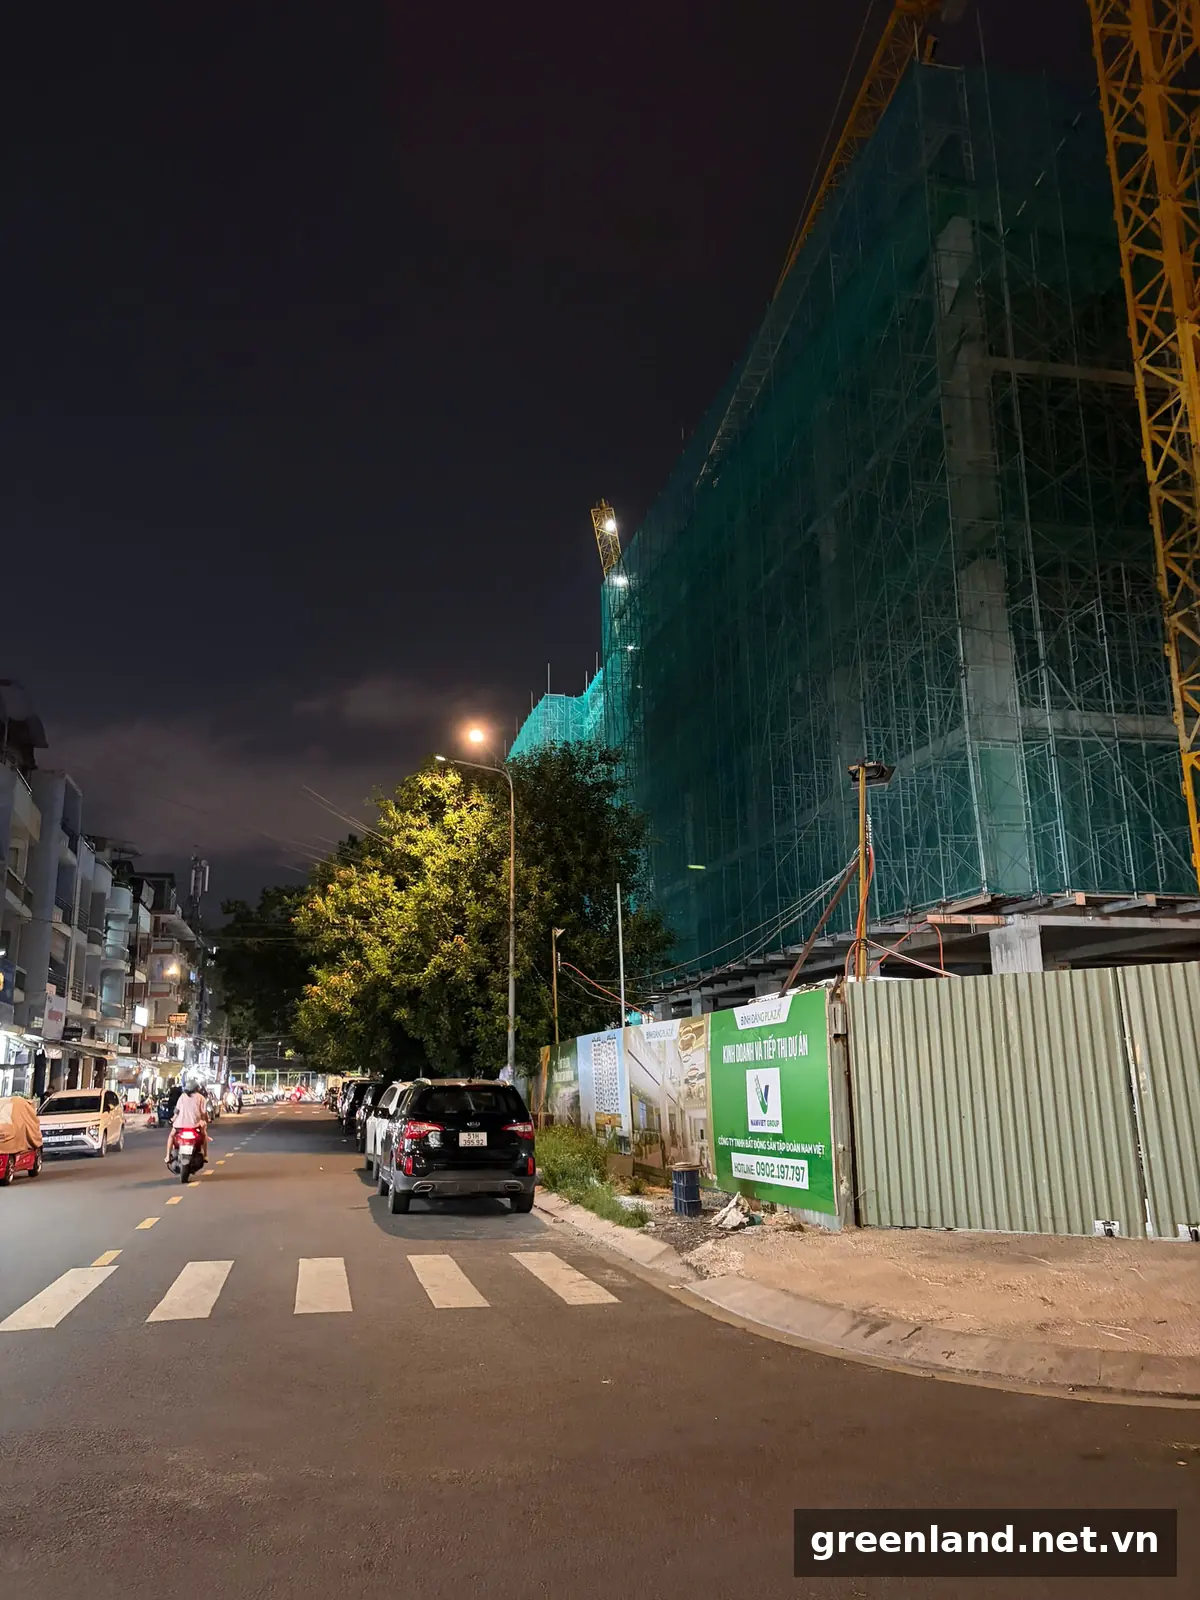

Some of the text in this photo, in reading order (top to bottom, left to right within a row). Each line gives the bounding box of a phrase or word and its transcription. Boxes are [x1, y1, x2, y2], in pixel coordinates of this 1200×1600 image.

[722, 1030, 808, 1064] KINH DOANH VÀ TIẾP THỊ DỰ ÁN
[766, 1119, 780, 1127] GROUP
[718, 1134, 825, 1158] CÔNG TY TNHH BẤT ĐỘNG SẢN TẬP ĐOÀN NAM VIỆT
[734, 1161, 805, 1183] HOTLINE: 0902.197.797
